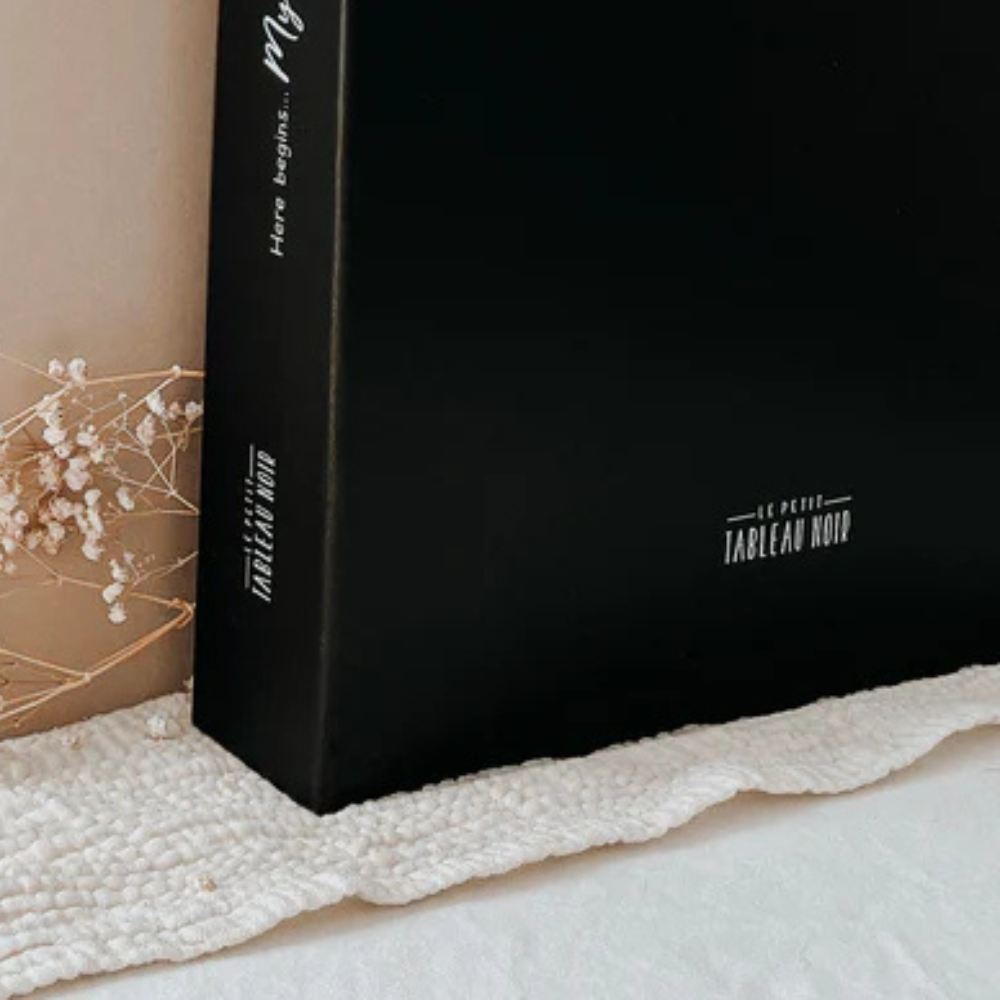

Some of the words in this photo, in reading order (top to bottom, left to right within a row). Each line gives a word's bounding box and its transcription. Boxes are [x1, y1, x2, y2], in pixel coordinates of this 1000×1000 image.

[270, 197, 285, 258] Here
[256, 449, 277, 503] NOIR
[756, 503, 775, 521] LE
[780, 493, 824, 517] PETIT
[252, 503, 275, 604] TABLEAU
[723, 516, 806, 566] TABLEAU
[810, 509, 852, 550] NOIR
